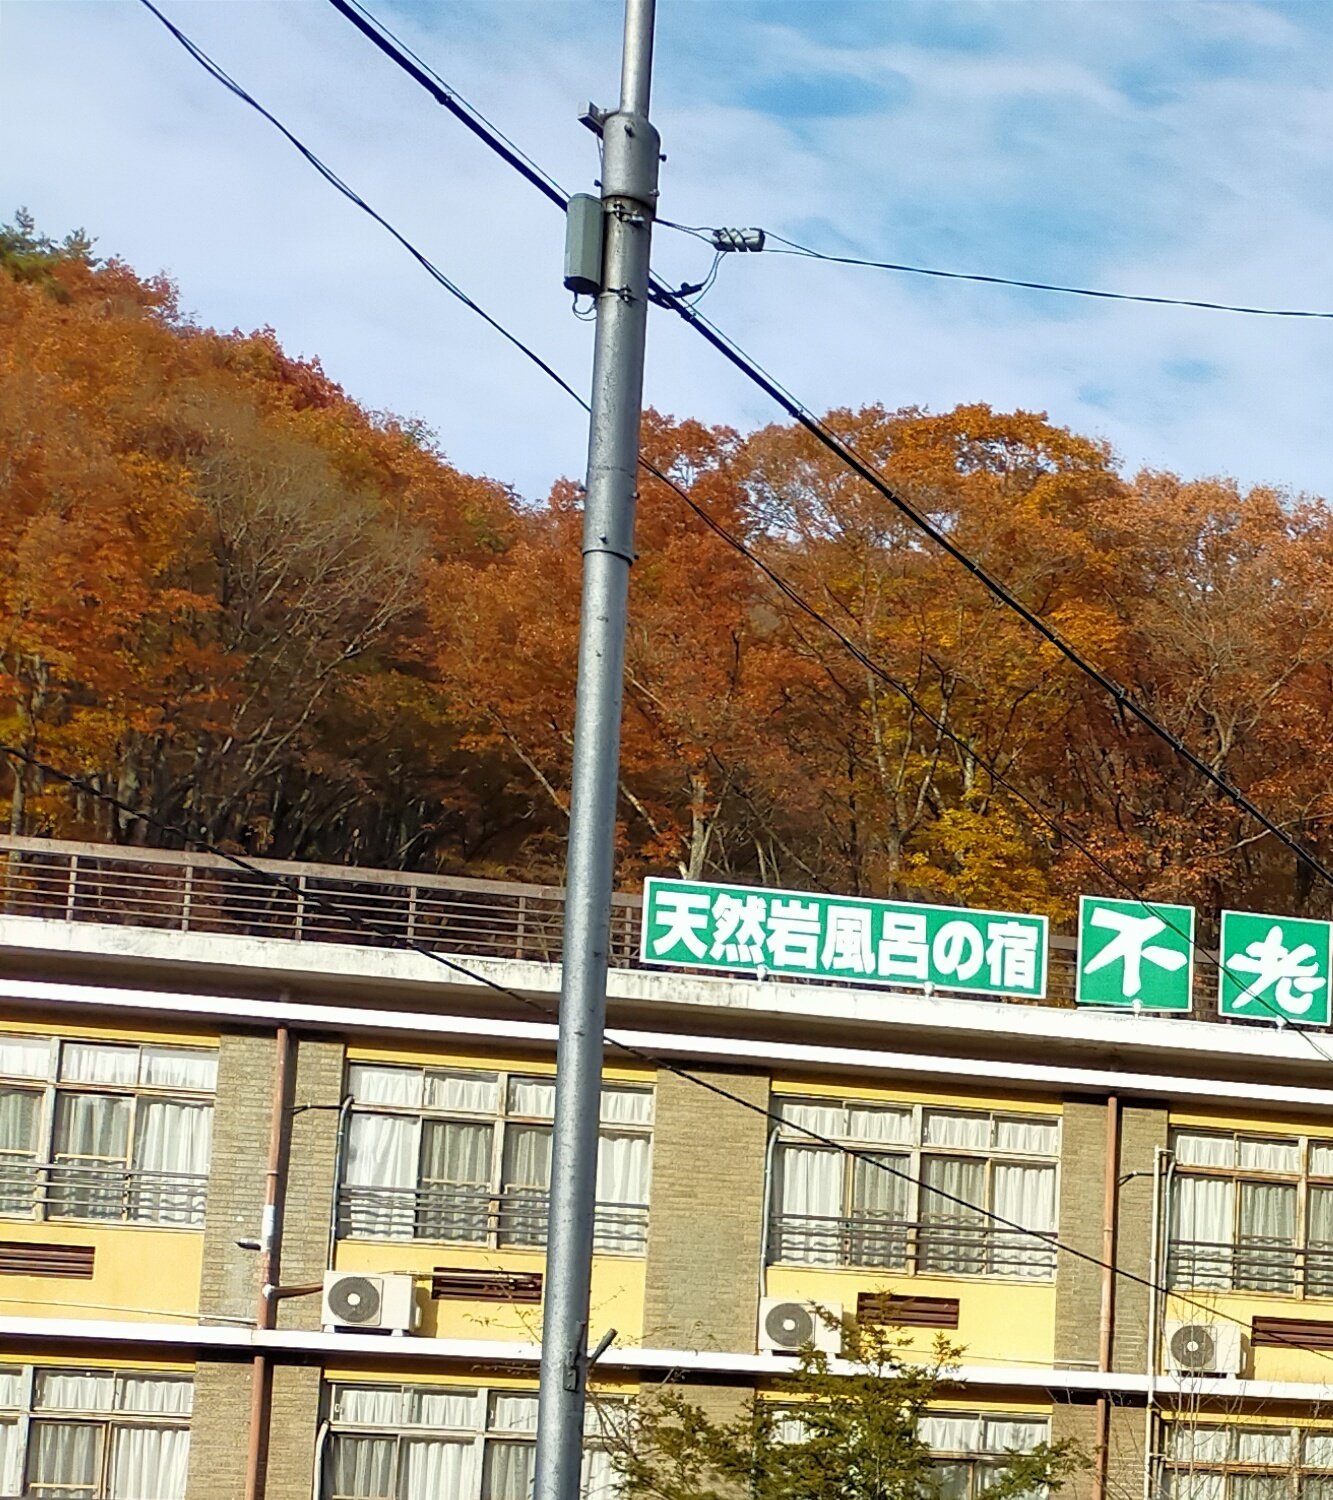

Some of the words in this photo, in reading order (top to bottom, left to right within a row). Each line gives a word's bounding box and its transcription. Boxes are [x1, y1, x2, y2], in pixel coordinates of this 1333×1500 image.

[652, 889, 1039, 989] 天然岩風呂の宿
